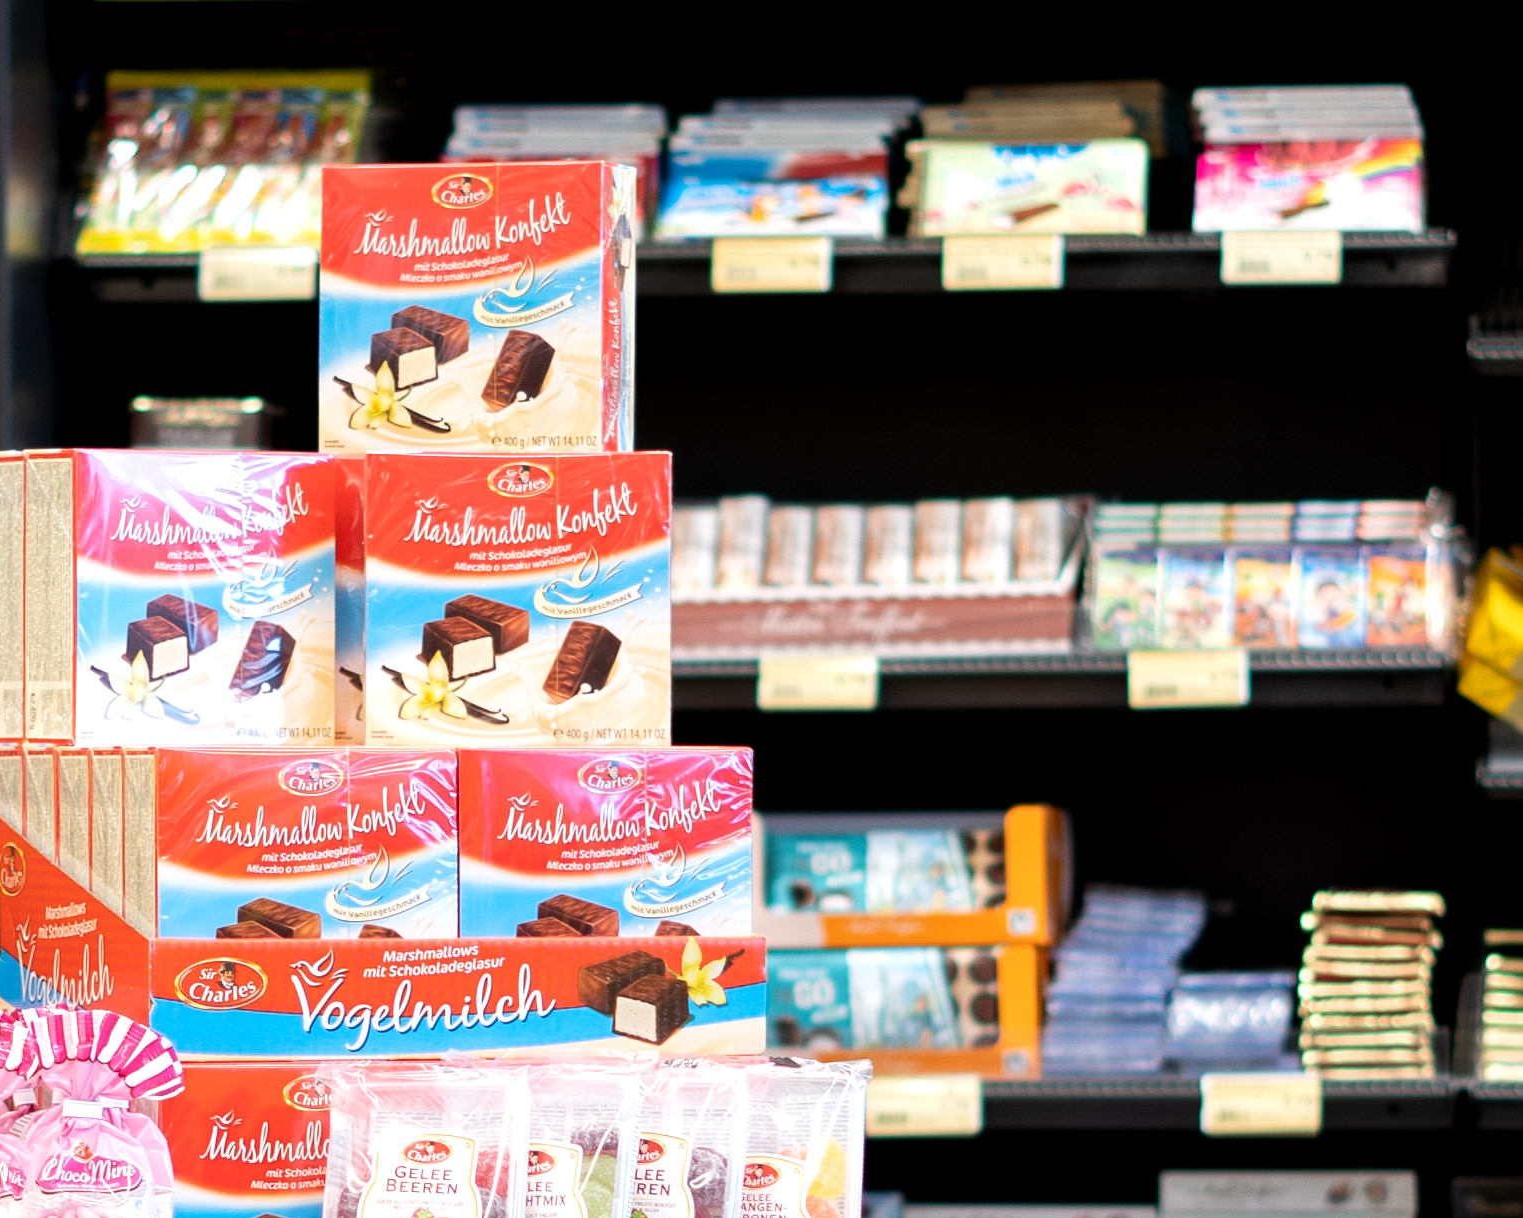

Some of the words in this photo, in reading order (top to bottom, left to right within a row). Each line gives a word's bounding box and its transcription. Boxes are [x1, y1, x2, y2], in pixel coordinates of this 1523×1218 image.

[440, 189, 486, 205] Charles
[354, 217, 491, 258] Marshmallow
[495, 191, 571, 250] Konfekt
[413, 262, 430, 272] mit
[430, 253, 510, 272] Schokoladeglasur
[443, 271, 471, 282] smaku
[503, 436, 518, 447] 400
[532, 436, 547, 447] NET
[548, 436, 561, 446] WT
[563, 435, 584, 447] 14.11
[586, 435, 597, 447] OZ
[497, 477, 546, 493] Charles
[403, 506, 552, 547] Marshmallow
[556, 482, 638, 540] Konfekt
[469, 551, 488, 561] mit
[488, 543, 573, 561] Schokoladeglasur
[501, 560, 531, 571] smaku
[532, 551, 587, 569] waniliowym
[557, 592, 633, 616] Vanillegeschmack
[288, 727, 300, 738] WT
[302, 727, 321, 738] 14.11
[322, 727, 332, 738] OZ
[566, 729, 581, 740] 400
[597, 729, 612, 739] NET
[613, 729, 627, 739] WT
[630, 729, 652, 740] 14.11
[655, 729, 666, 739] OZ
[287, 776, 336, 792] Charles
[587, 773, 634, 790] Charles
[195, 805, 343, 847] Marshmallow
[346, 782, 426, 840] Konfekt
[497, 802, 640, 845] Marshmallow
[644, 780, 722, 836] Konfekt
[261, 853, 279, 862] mit
[279, 843, 364, 862] Schokoladeglasur
[561, 850, 578, 860] mit
[579, 841, 660, 860] Schokoladeglasur
[292, 862, 322, 874] smaku
[592, 859, 621, 871] smaku
[646, 890, 717, 915] Vanillegeschmack
[383, 945, 479, 963] Marshmallows
[16, 934, 115, 1007] Vogelmilch
[198, 967, 217, 981] Sir
[363, 966, 387, 978] mit
[389, 956, 506, 979] Schokoladeglasur
[189, 981, 257, 1004] Charles
[290, 964, 556, 1052] Vogelmilch
[199, 1120, 330, 1163] Marshmallo
[407, 1149, 448, 1162] Charles
[41, 1152, 90, 1183] Choco
[266, 1168, 283, 1178] mit
[394, 1165, 452, 1181] GELEE
[634, 1169, 666, 1182] LEE
[386, 1178, 458, 1195] BEEREN
[528, 1182, 553, 1193] LEE
[526, 1195, 566, 1206] HTMIX
[741, 1203, 788, 1213] ANGEN-
